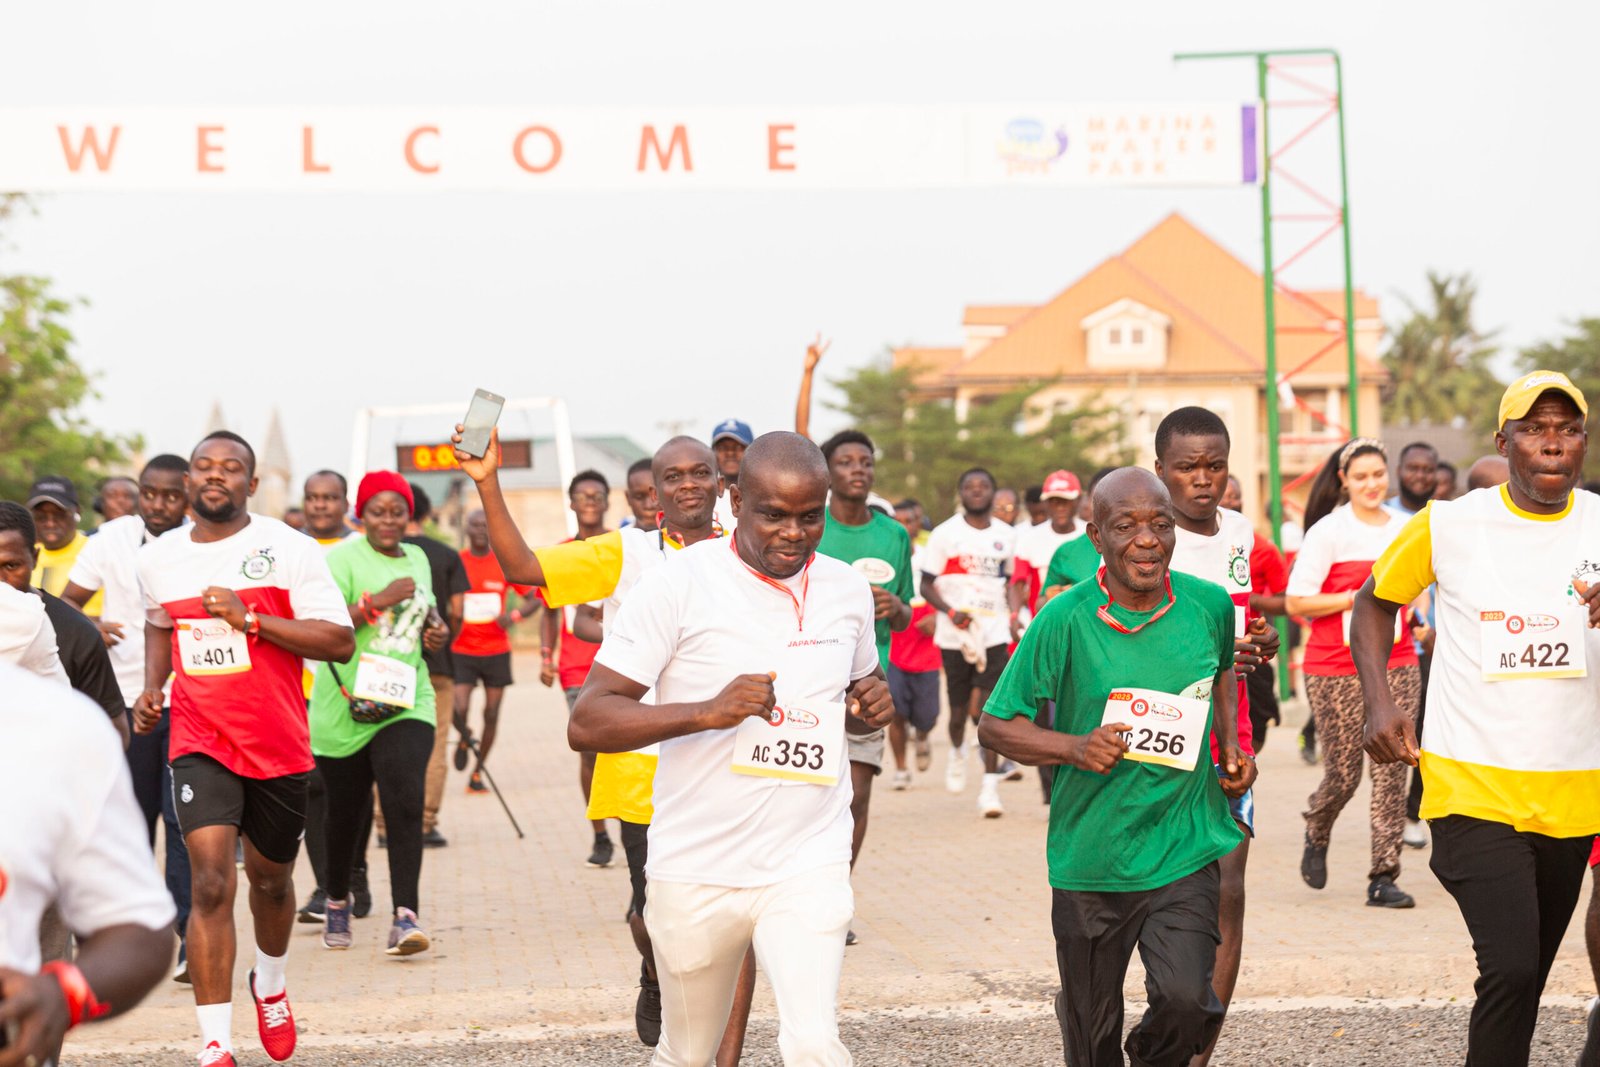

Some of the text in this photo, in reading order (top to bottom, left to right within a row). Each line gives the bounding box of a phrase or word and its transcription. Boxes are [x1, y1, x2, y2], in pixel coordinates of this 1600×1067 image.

[56, 123, 799, 174] WELCOME
[1087, 159, 1168, 176] PARK
[204, 647, 236, 667] 401
[1500, 642, 1570, 669] AC 422
[379, 681, 407, 699] 457
[751, 739, 824, 770] AC 353
[1135, 728, 1186, 756] 256
